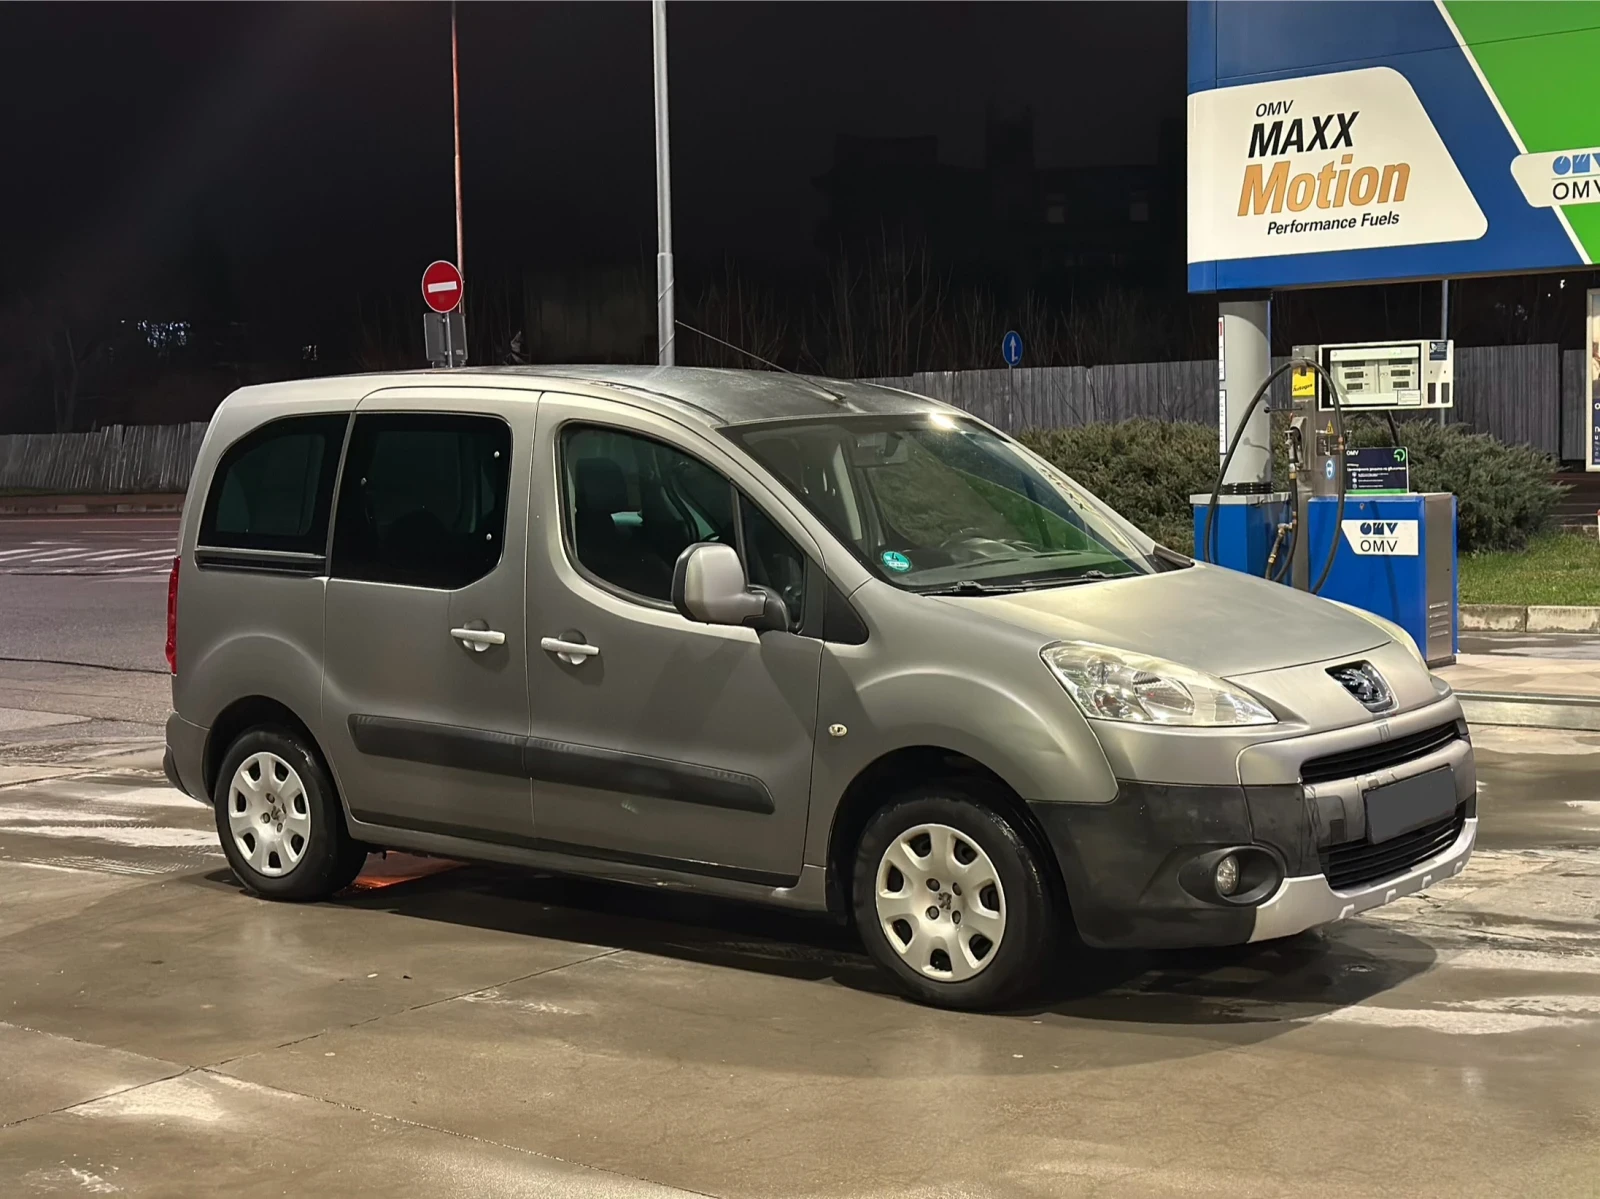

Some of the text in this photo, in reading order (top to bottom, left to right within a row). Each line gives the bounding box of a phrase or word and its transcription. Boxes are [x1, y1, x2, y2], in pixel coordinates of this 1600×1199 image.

[1256, 100, 1294, 117] OMV
[1248, 111, 1360, 158] MAXX
[1237, 154, 1411, 216] Motion
[1267, 211, 1400, 235] Performance Fuels
[1360, 522, 1399, 535] OMV
[1360, 540, 1398, 552] OMV
